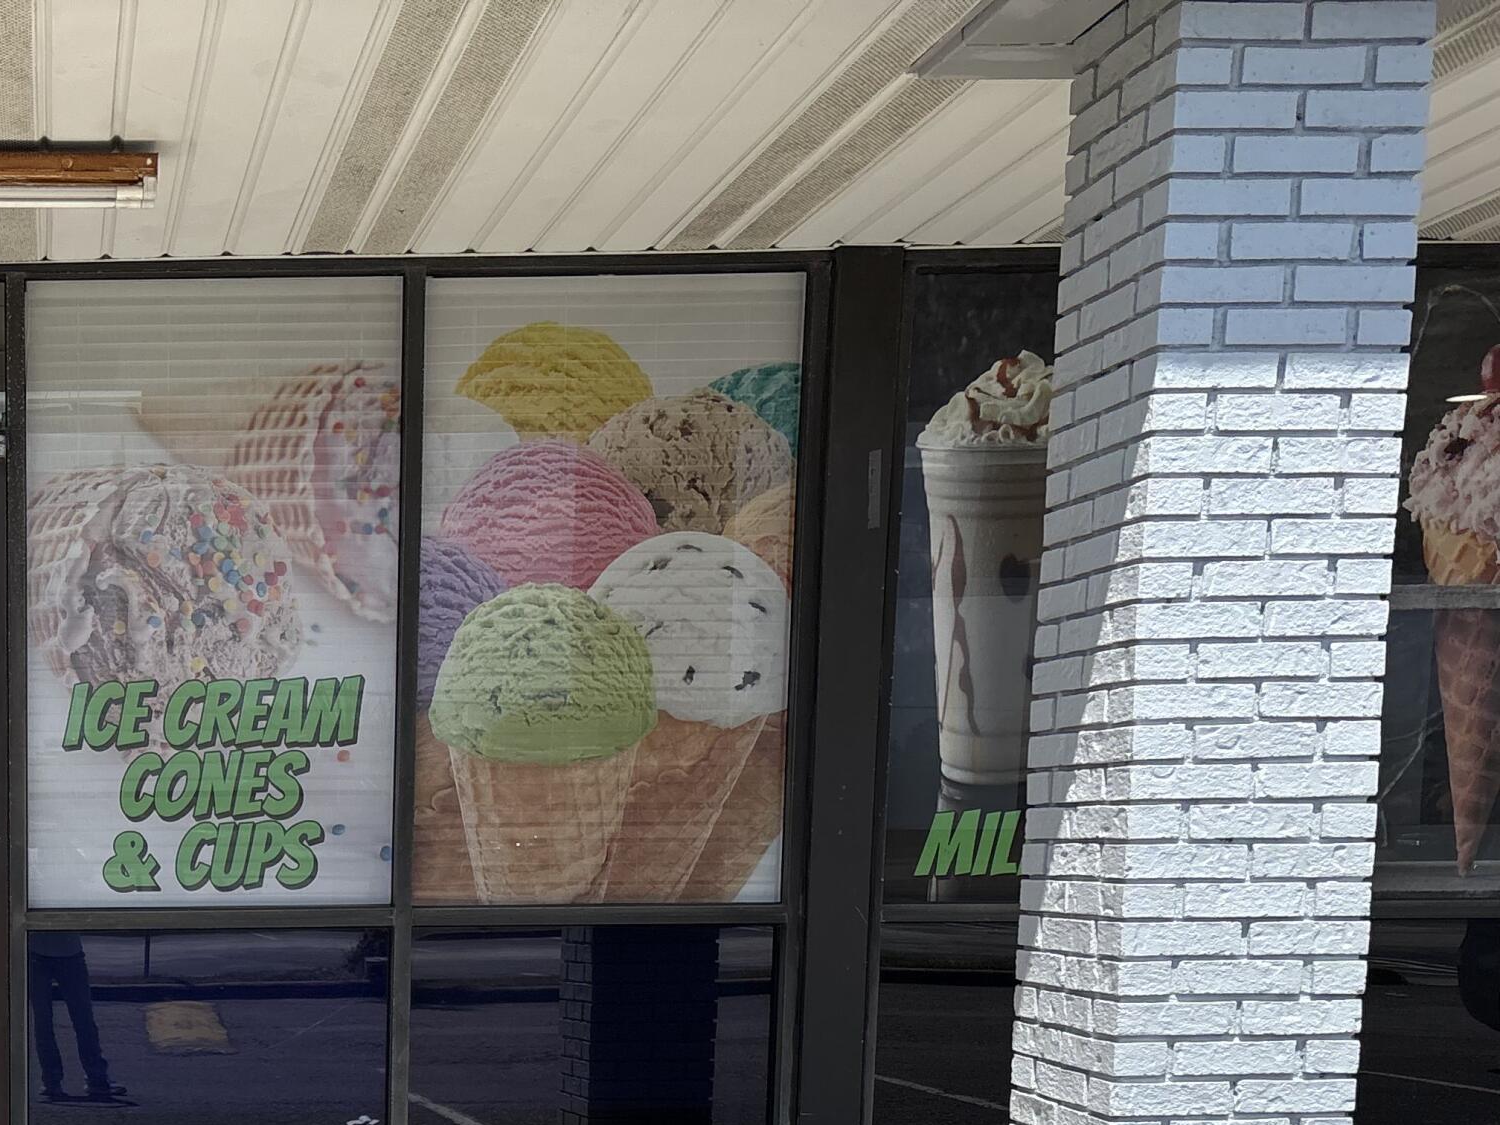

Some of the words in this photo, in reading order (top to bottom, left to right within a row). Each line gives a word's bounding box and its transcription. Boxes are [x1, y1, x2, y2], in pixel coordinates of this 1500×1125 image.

[62, 679, 159, 751] ICE
[163, 675, 365, 751] CREAM
[119, 750, 310, 822] CONES
[102, 831, 161, 893] &
[175, 820, 325, 891] CUPS
[913, 808, 1021, 877] MIL
